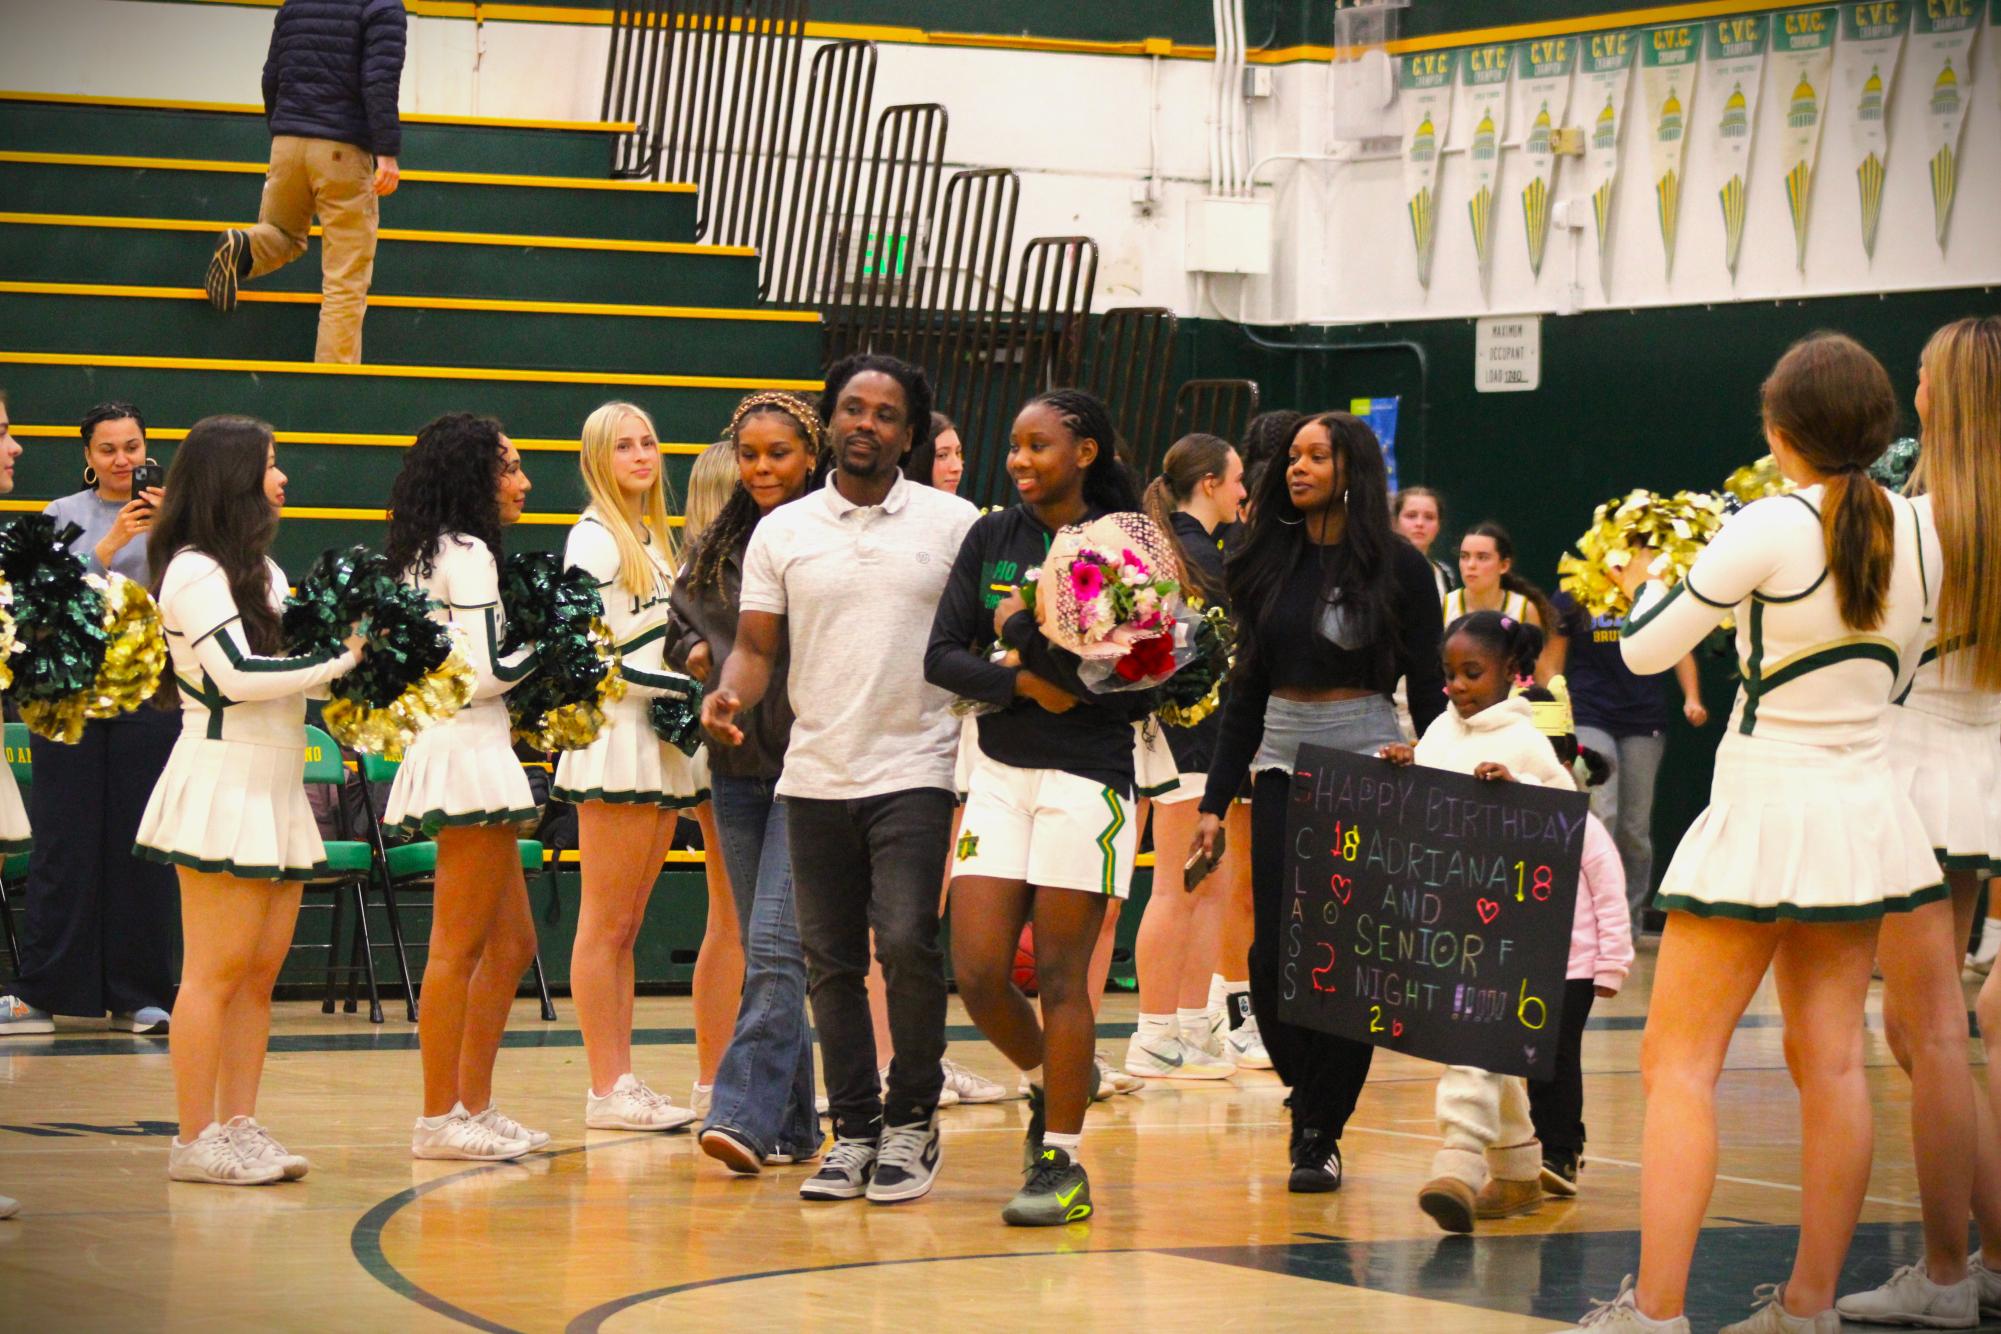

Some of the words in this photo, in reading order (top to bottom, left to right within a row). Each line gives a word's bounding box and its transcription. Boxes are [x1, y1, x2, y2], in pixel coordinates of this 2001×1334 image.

[1489, 346, 1525, 361] OCCUPANT
[1492, 324, 1523, 337] MAXIMUM
[1314, 767, 1415, 825] HAPPY
[1426, 787, 1585, 852] BIRTHDAY
[1330, 820, 1360, 861] 18
[1366, 829, 1508, 896] ADRIANA
[1514, 861, 1552, 902] 18
[1381, 884, 1441, 925] AND
[1354, 914, 1484, 977] SENIOR
[1355, 965, 1441, 1011] NIGHT
